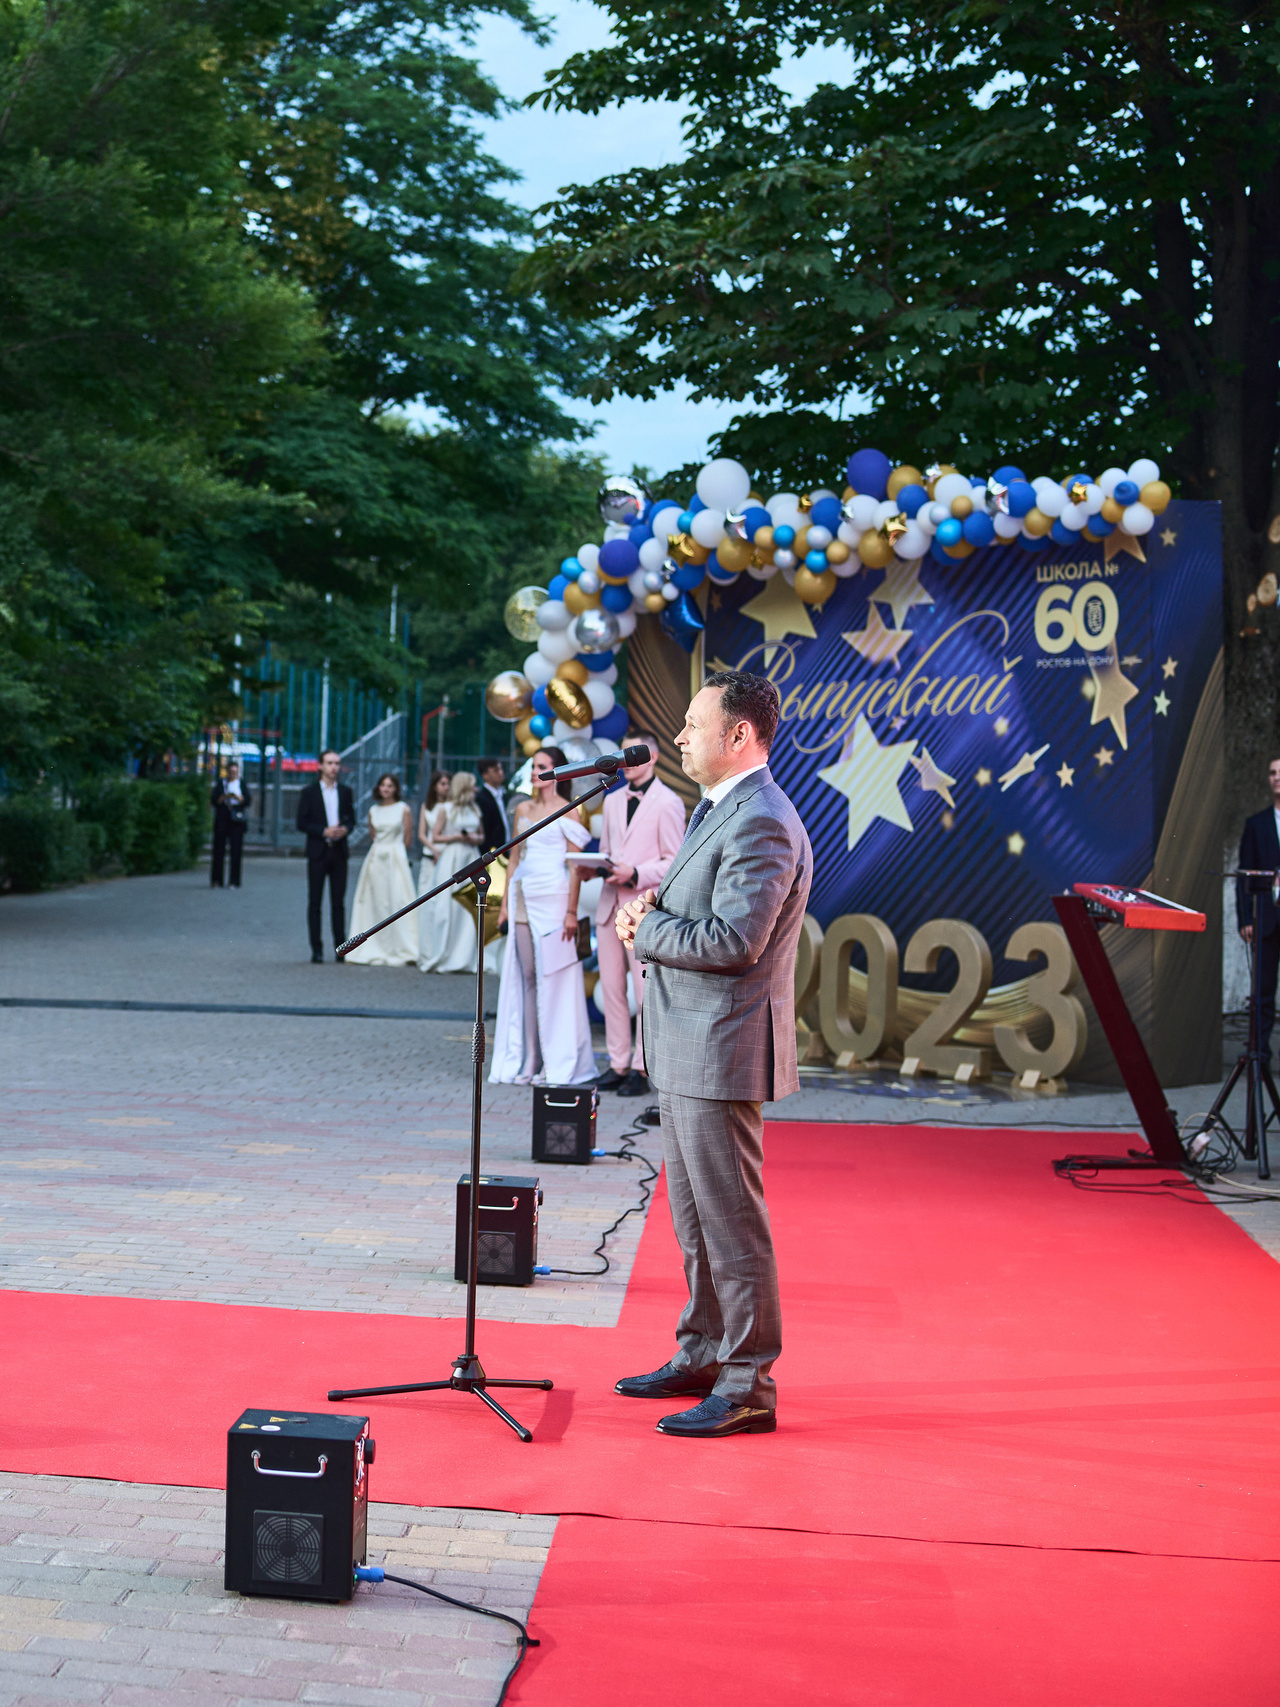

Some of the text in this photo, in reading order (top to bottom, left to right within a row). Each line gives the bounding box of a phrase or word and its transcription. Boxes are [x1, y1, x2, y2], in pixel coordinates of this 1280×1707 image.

[1036, 561, 1119, 583] ШКОЛА №
[1034, 581, 1119, 654] 60
[735, 610, 1023, 754] Выпускной
